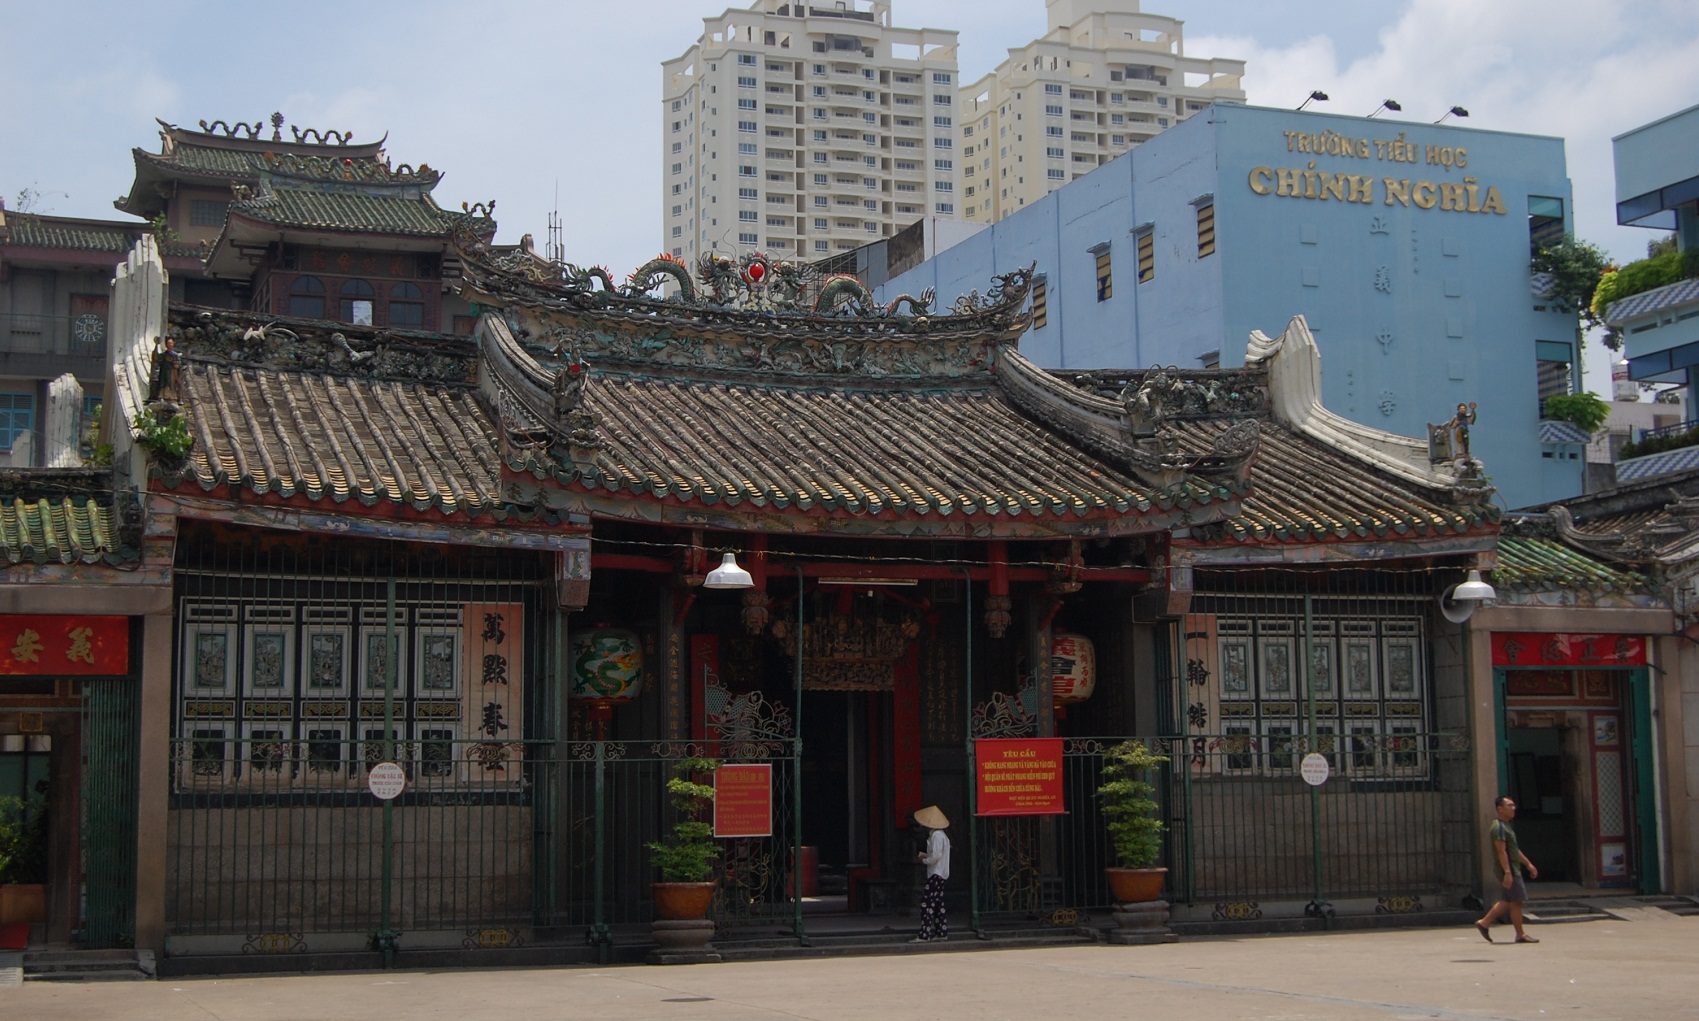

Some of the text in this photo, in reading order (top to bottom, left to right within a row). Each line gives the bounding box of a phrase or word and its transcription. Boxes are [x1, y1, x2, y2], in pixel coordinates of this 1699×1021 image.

[1283, 128, 1468, 172] TRƯỜNG TIỂU HỌC
[1248, 160, 1507, 215] CHÍNH NGHĨA
[1020, 748, 1036, 757] CẦU
